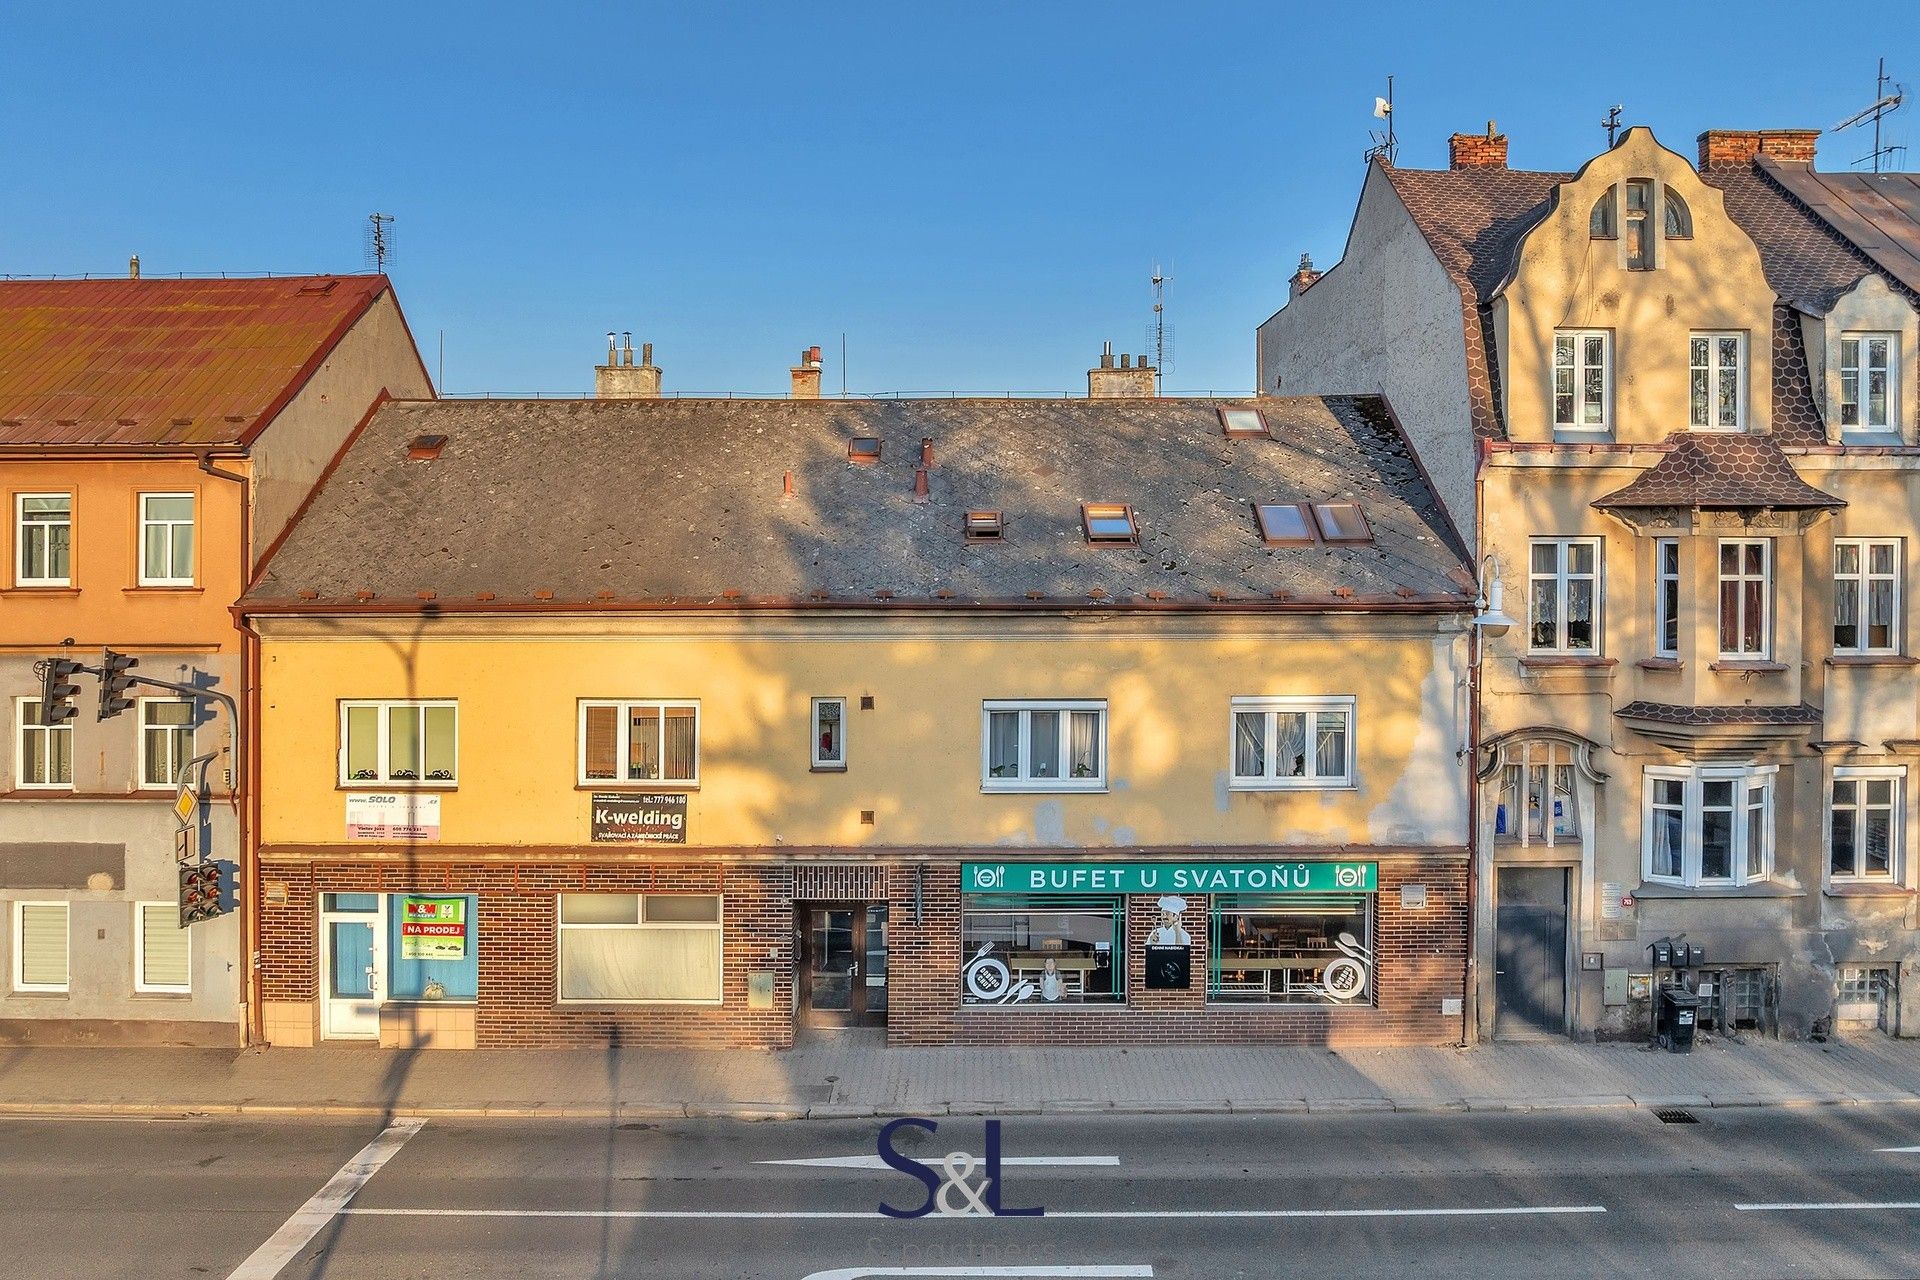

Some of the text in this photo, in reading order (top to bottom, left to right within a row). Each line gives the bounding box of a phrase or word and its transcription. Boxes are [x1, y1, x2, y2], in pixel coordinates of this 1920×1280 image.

[595, 809, 683, 830] K-welding
[1030, 864, 1310, 889] BUFET U SVATOŇŮ
[407, 926, 461, 935] NA PRODEJ
